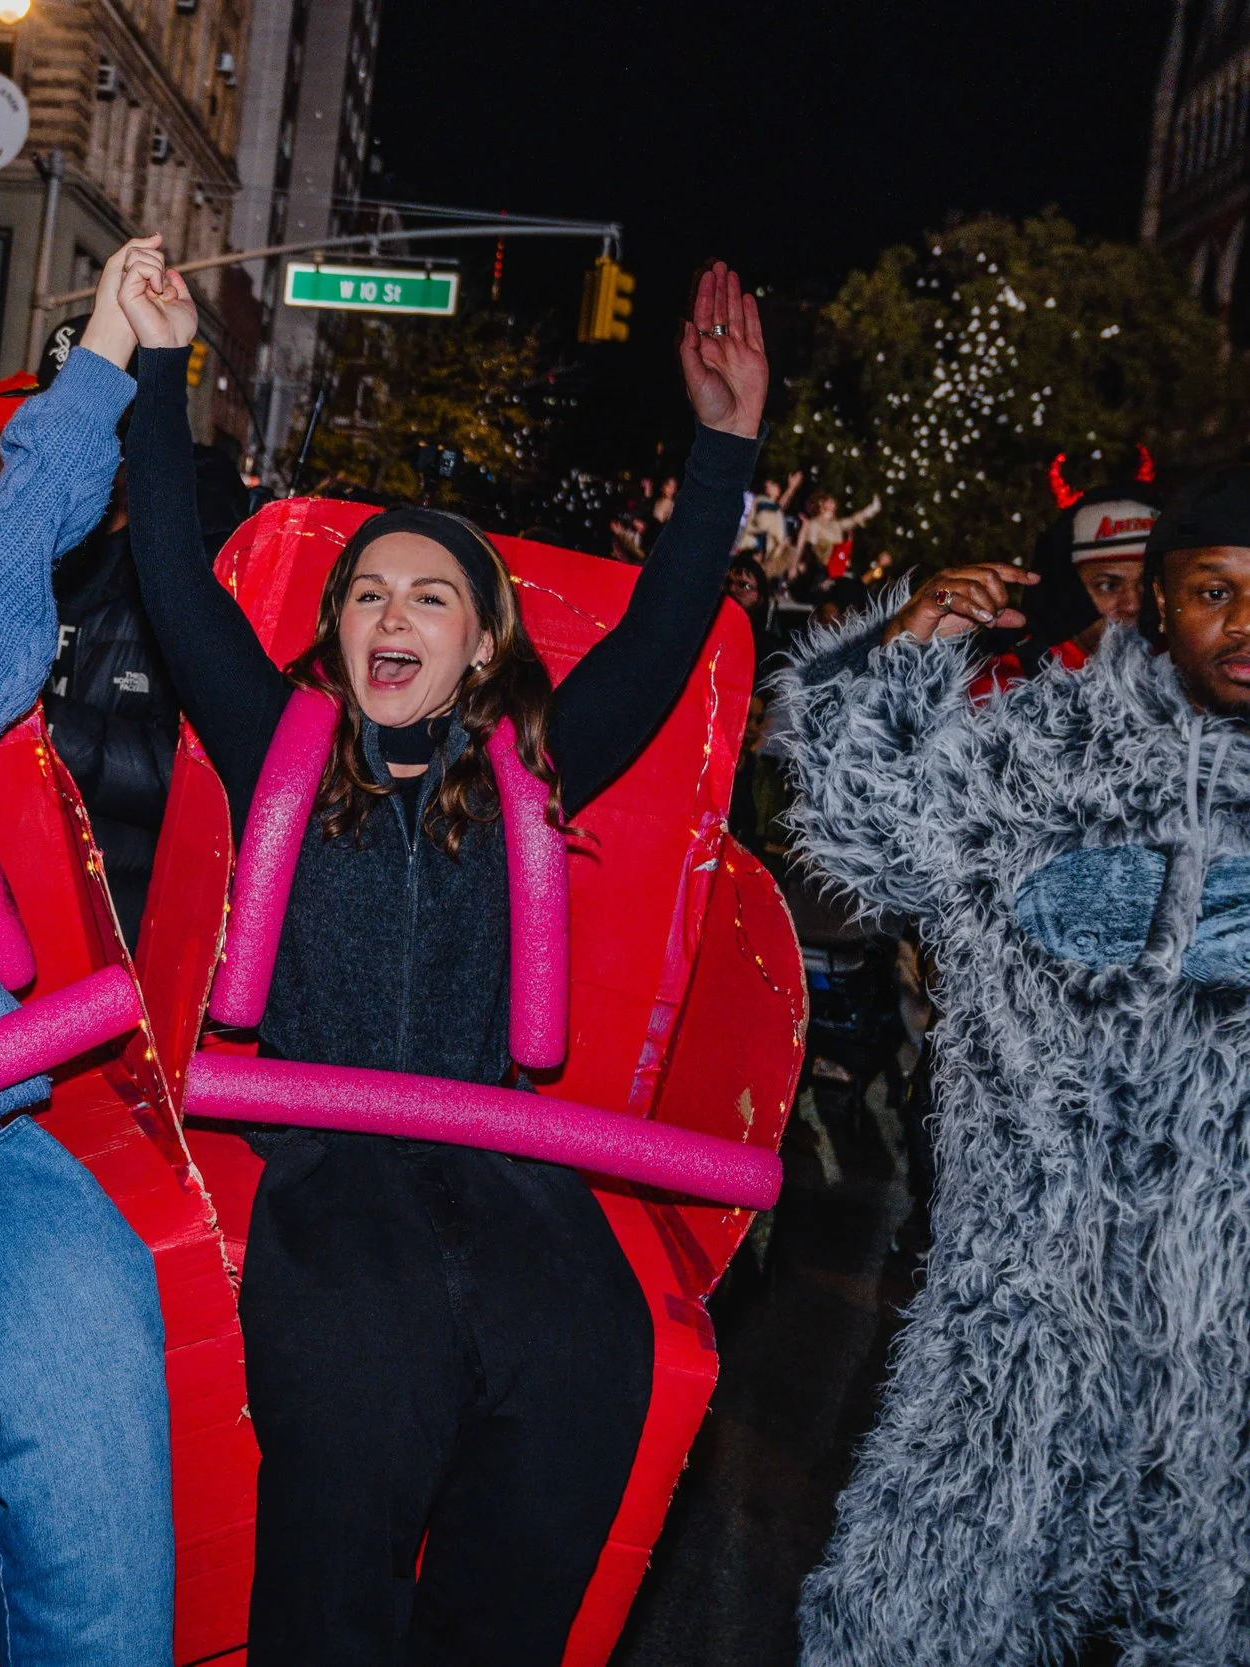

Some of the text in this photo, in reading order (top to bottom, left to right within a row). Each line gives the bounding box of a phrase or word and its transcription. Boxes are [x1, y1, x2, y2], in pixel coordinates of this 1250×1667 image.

[339, 280, 402, 303] W 10 St
